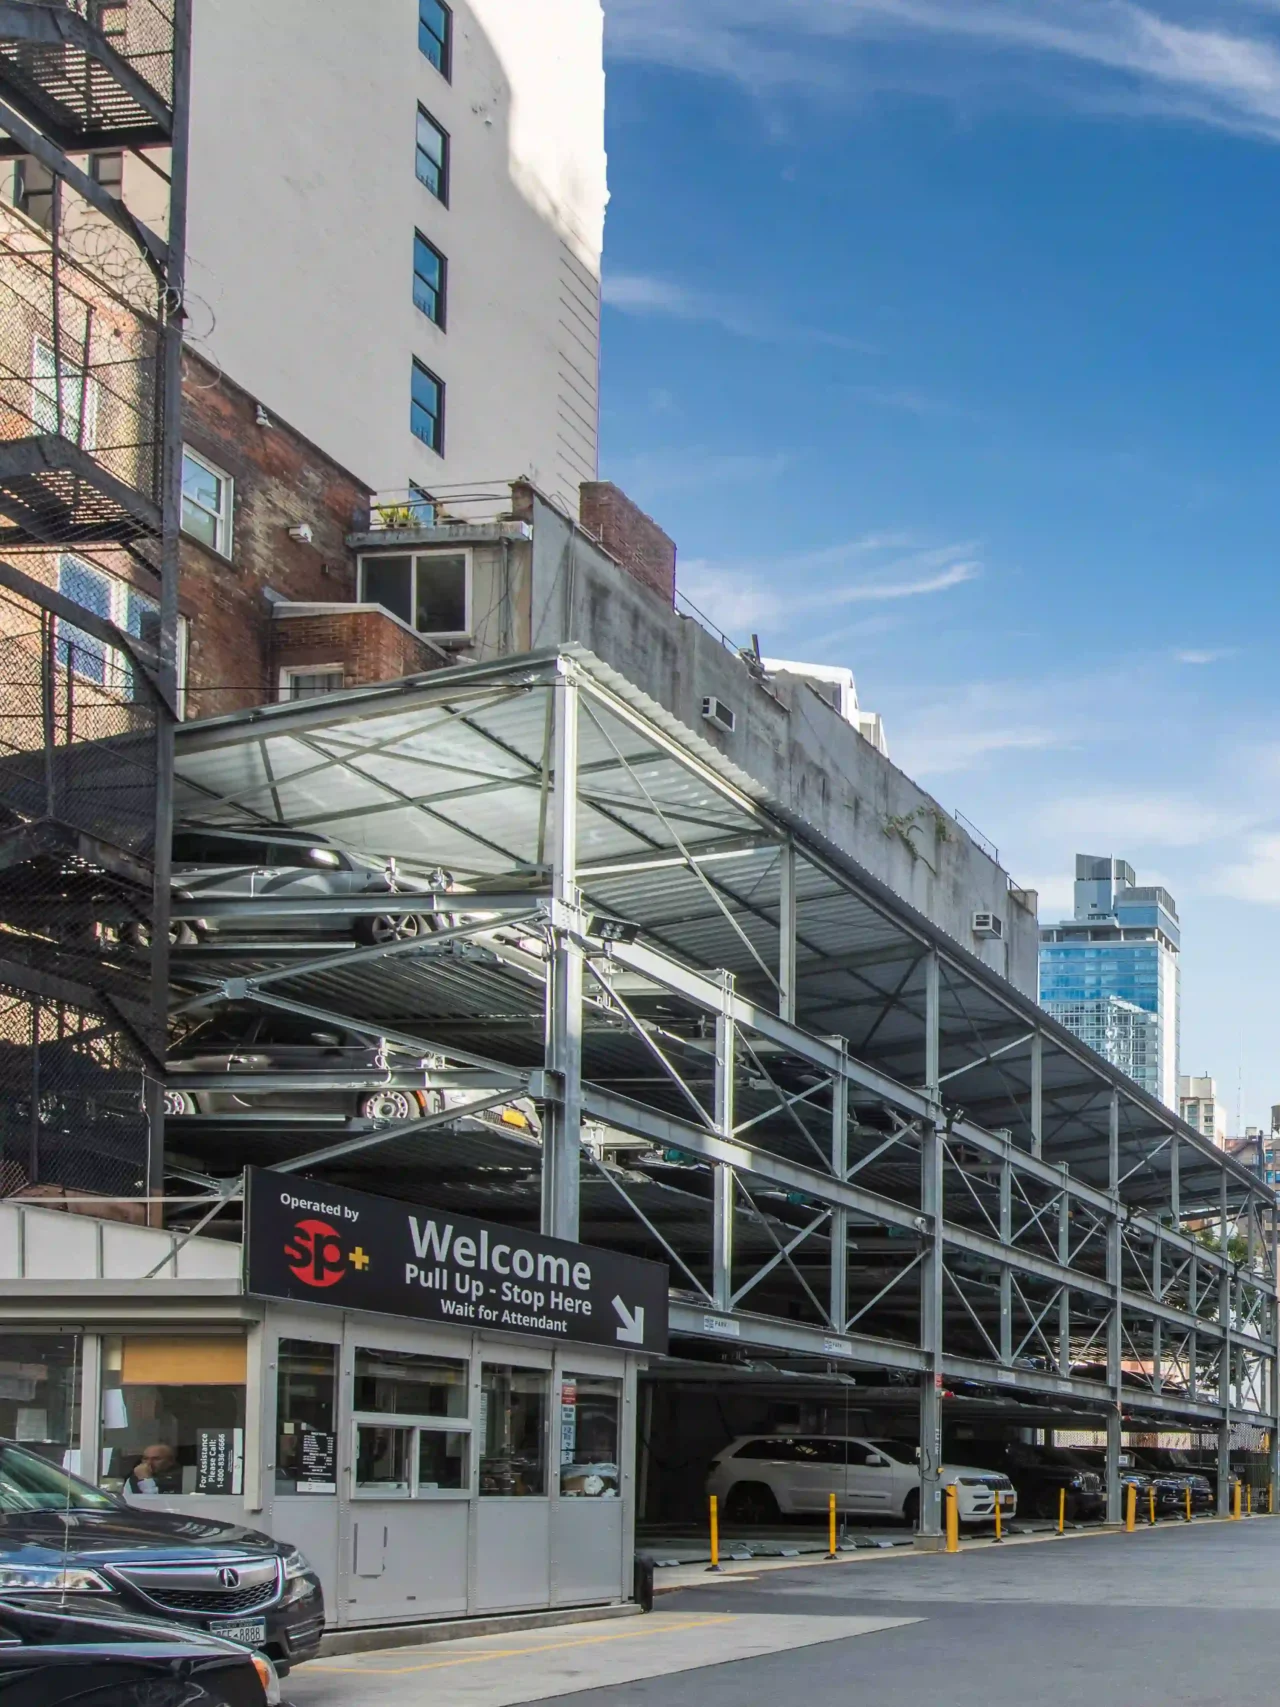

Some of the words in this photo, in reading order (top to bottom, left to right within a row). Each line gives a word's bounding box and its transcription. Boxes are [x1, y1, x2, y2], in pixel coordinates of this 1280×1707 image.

[280, 1193, 341, 1216] Operated
[344, 1206, 359, 1222] by
[408, 1215, 591, 1290] Welcome
[405, 1263, 448, 1290] Pull
[455, 1273, 484, 1302] Up
[501, 1281, 545, 1312] Stop
[550, 1290, 592, 1316] Here
[440, 1298, 474, 1318] Wait
[478, 1304, 498, 1321] for
[501, 1310, 568, 1333] Attendant
[200, 1433, 209, 1474] Assistance
[209, 1439, 217, 1457] Call:
[217, 1433, 225, 1488] 1-800-836-6666
[199, 1475, 207, 1488] For
[208, 1457, 217, 1482] Please
